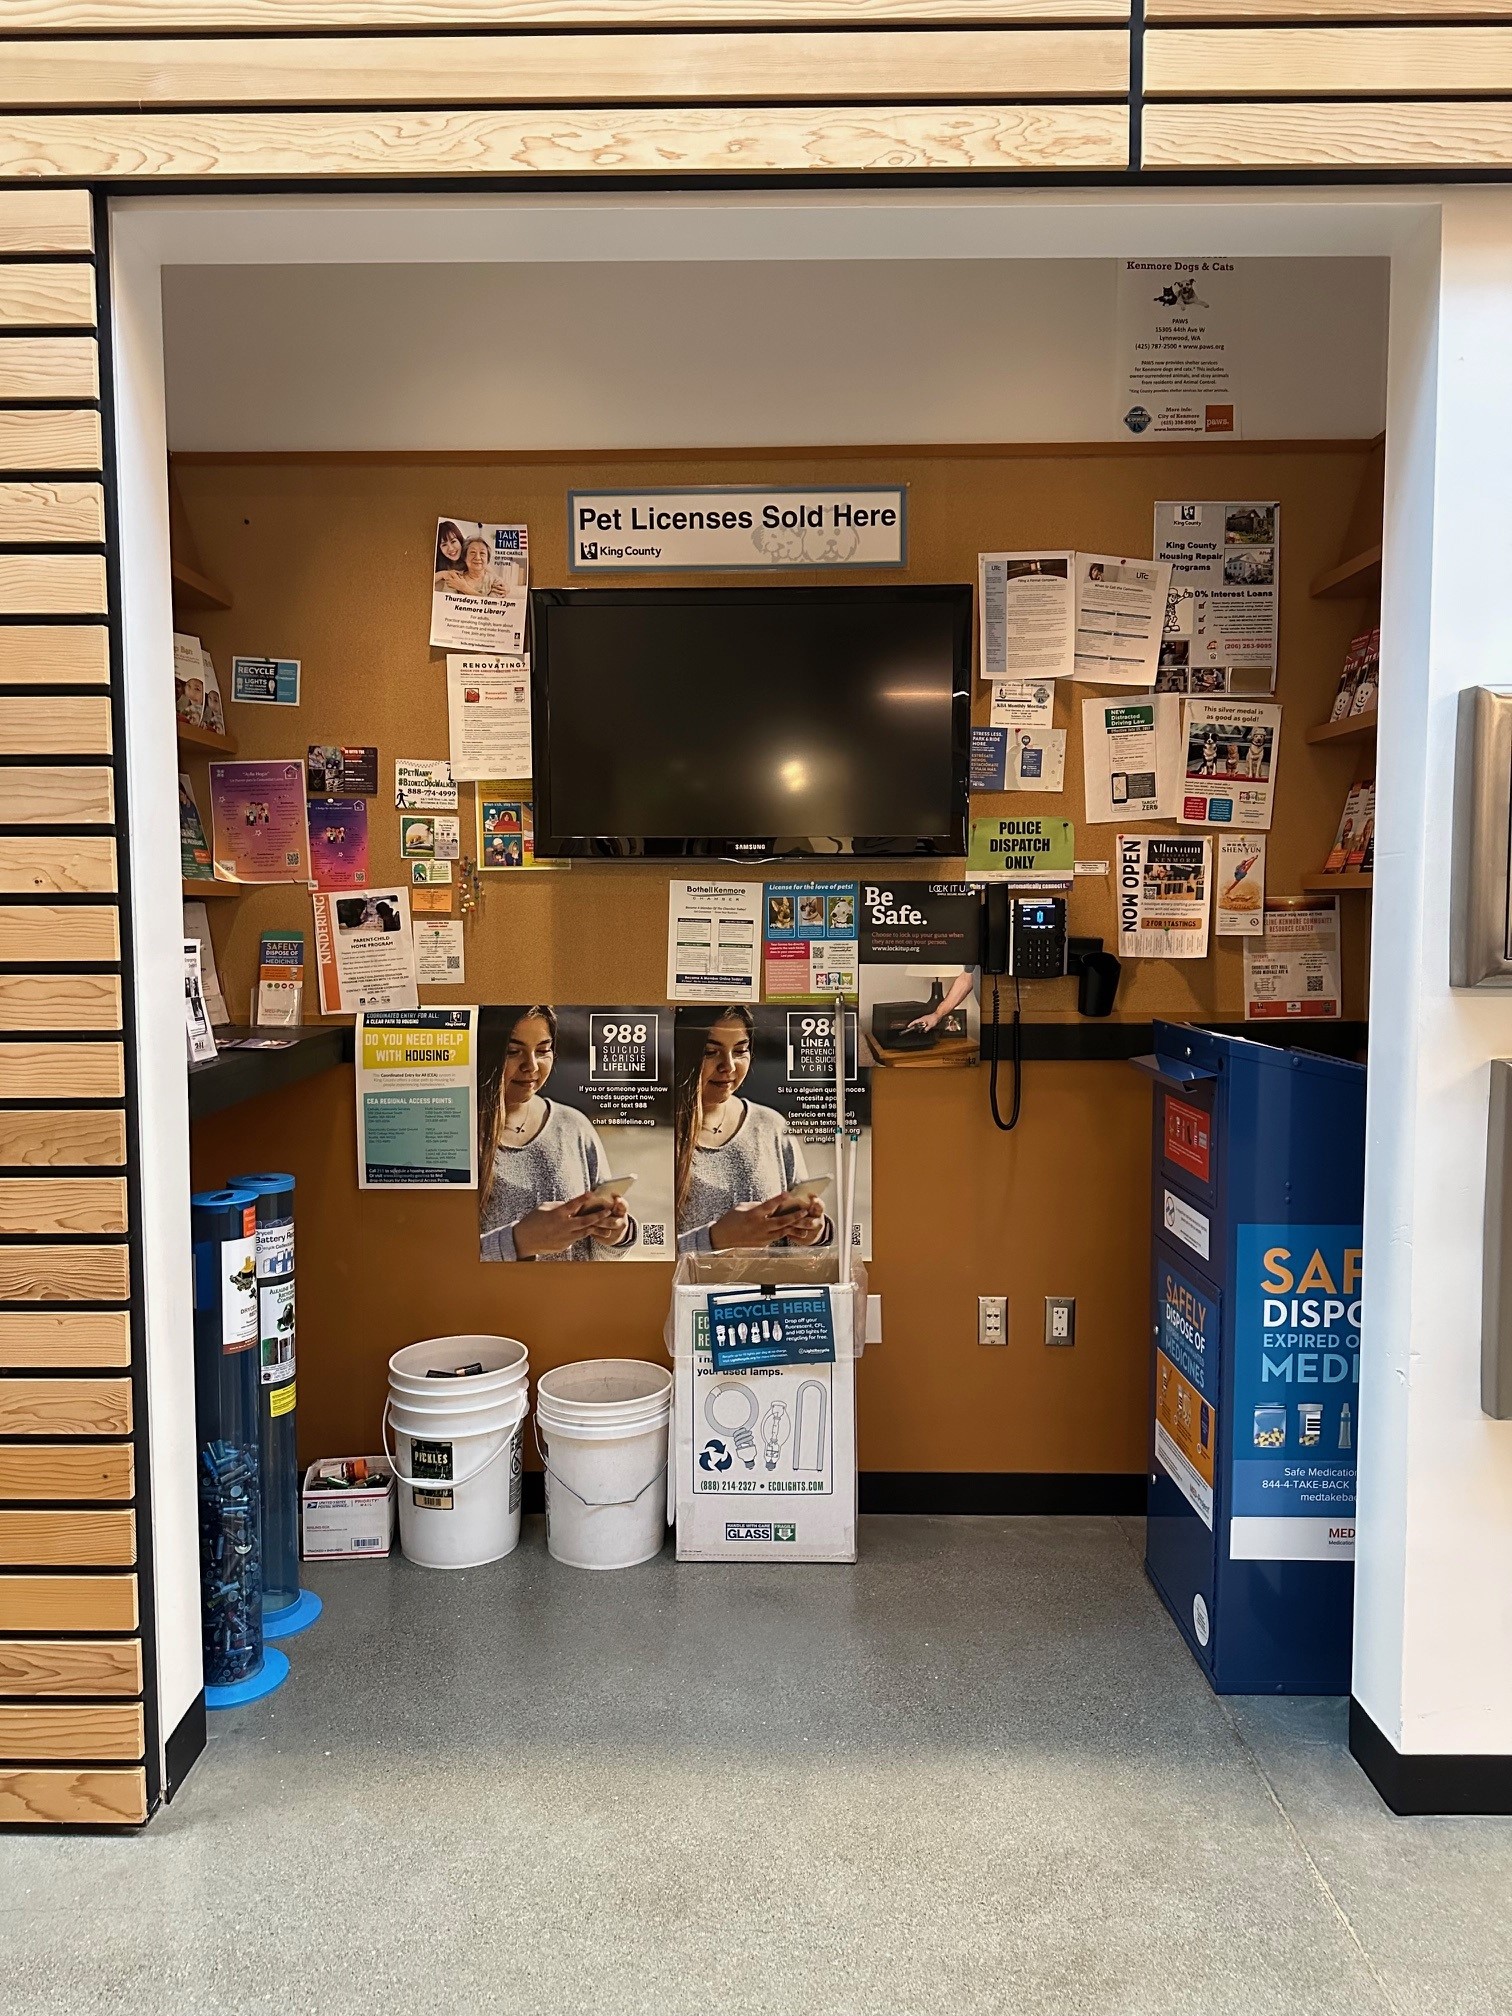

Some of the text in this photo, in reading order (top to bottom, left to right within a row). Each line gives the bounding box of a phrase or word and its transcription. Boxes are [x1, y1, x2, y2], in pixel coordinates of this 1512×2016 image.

[1126, 262, 1234, 272] Kenmore Dogs & Cats
[1206, 418, 1229, 427] paws.
[579, 504, 896, 530] Pet Licenses Sold Here
[498, 531, 518, 540] TALK
[498, 540, 518, 549] TIME
[1166, 542, 1217, 550] King County
[600, 546, 662, 558] King County
[1160, 553, 1223, 561] Housing Repair
[445, 595, 516, 607] Thursdays, 10am-12pm
[455, 605, 506, 616] Kenmore Library
[238, 666, 275, 675] RECYCLE
[407, 788, 456, 797] 888-774-4999
[1000, 822, 1042, 835] POLICE
[990, 838, 1050, 852] DISPATCH
[1005, 856, 1035, 869] ONLY
[929, 884, 948, 892] LOCK
[1122, 840, 1141, 932] NOW OPEN
[865, 887, 893, 905] Be
[872, 905, 927, 925] Safe.
[318, 895, 331, 964] KINDERING
[366, 1034, 463, 1045] DO YOU NEED HELP
[603, 1024, 646, 1044] 988
[801, 1037, 830, 1047] LÍNEA
[376, 1050, 456, 1062] WITH HOUSING?
[603, 1063, 646, 1071] LIFELINE
[1260, 1248, 1362, 1294] SAF
[1166, 1275, 1206, 1333] SAFELY
[714, 1301, 826, 1320] RECYCLE HERE!
[1263, 1300, 1361, 1328] DISPO
[1166, 1303, 1206, 1353] DISPOSE OF
[1264, 1334, 1360, 1348] EXPIRED O
[1166, 1334, 1205, 1389] MEDICINES
[750, 1367, 783, 1378] lamps.
[1262, 1353, 1360, 1383] MEDI
[414, 1451, 448, 1464] PICKLES
[1285, 1468, 1306, 1476] Safe
[700, 1481, 823, 1491] (888) 214-2327 ECOLIGHTS.COM
[1262, 1480, 1349, 1489] 844-4-TAKE-BACK
[728, 1529, 770, 1539] GLASS
